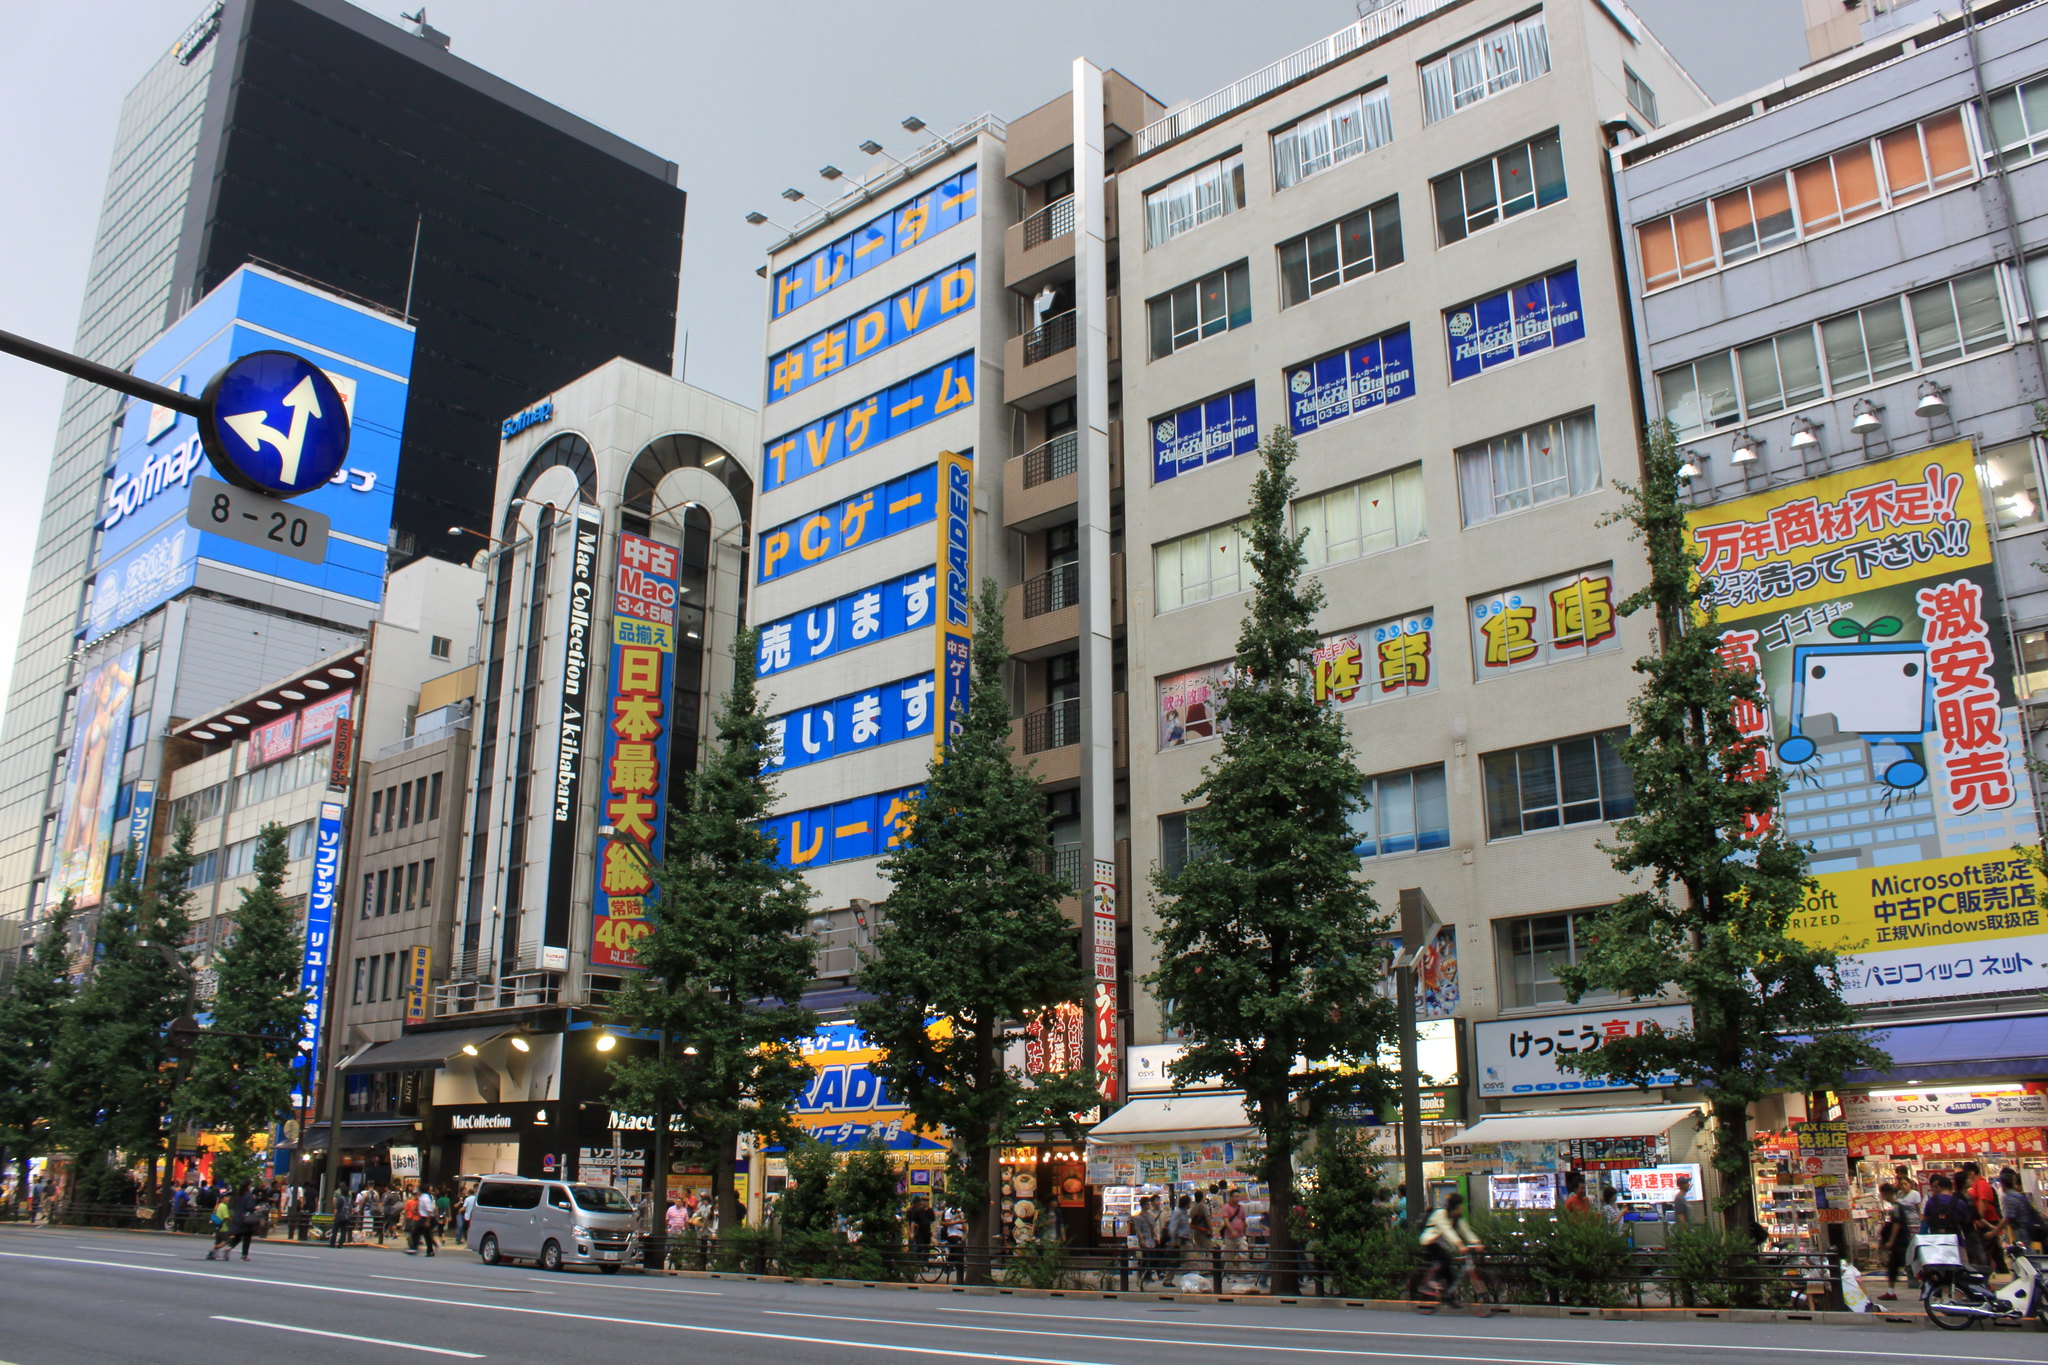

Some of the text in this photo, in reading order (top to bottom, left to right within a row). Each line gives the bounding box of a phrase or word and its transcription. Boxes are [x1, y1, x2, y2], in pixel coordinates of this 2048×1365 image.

[777, 187, 976, 314] トレーダー
[773, 268, 974, 393] 中古DVD
[1524, 310, 1579, 336] Station
[1360, 369, 1410, 393] Station
[501, 403, 553, 440] Sofmap
[770, 368, 973, 484] TVゲーム
[1299, 385, 1401, 428] TEL 03-5296-1090
[1212, 424, 1254, 446] Station
[104, 432, 203, 529] Sofmap
[575, 530, 597, 578] Mac
[763, 492, 939, 577] PCゲー
[947, 462, 970, 627] TRADER
[622, 539, 678, 578] 中古
[619, 567, 676, 606] Mac
[1704, 571, 1757, 594] ソコン
[565, 582, 592, 694] Collection
[618, 623, 669, 648] 品揃え
[759, 573, 937, 675] 売ります
[1480, 576, 1616, 667] 倉庫
[946, 640, 968, 659] 中古
[1313, 633, 1432, 705] 体育
[1163, 686, 1211, 711] 飲み放題
[1918, 579, 2015, 815] 激安販売
[335, 720, 349, 770] とらのあな
[555, 702, 581, 822] Akihabara
[330, 770, 346, 783] 3F
[605, 647, 662, 892] 日本最大級
[313, 830, 339, 910] ソフマップ
[1871, 858, 2034, 898] Microsoft認定
[611, 899, 642, 917] 常時
[1873, 883, 2037, 925] 中古PC販売店
[1875, 910, 2041, 944] 正規Windows取扱店
[1841, 968, 1860, 978] 株式
[1981, 952, 2033, 978] ネット
[1843, 981, 1862, 990] 会社
[1483, 1082, 1505, 1090] IOSYS
[1820, 1122, 1847, 1131] FREE
[1897, 1104, 1941, 1114] SONY
[1950, 1102, 1988, 1111] SAMSUNG
[1799, 1132, 1847, 1148] 免税店
